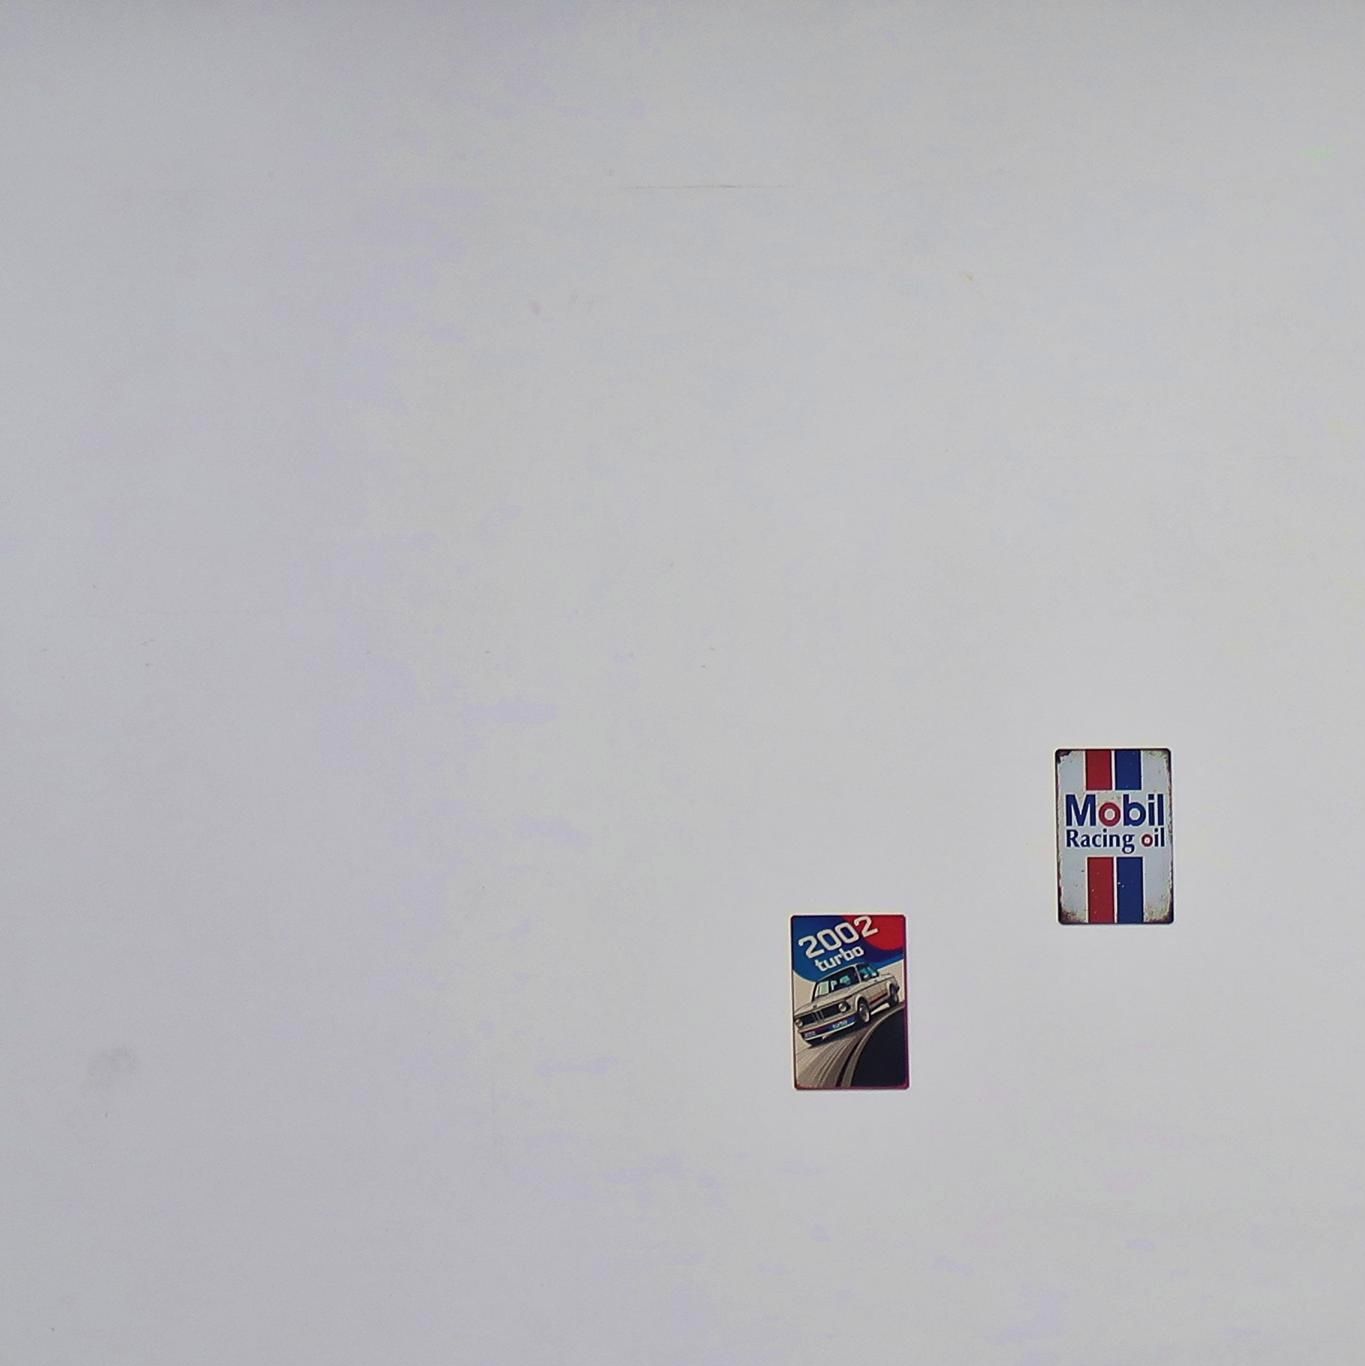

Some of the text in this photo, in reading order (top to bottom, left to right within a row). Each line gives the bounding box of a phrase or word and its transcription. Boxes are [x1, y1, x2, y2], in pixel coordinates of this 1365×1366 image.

[1065, 793, 1164, 828] Mobil
[1066, 828, 1165, 854] Racing oil
[798, 916, 879, 959] 2002
[815, 946, 865, 972] turbo
